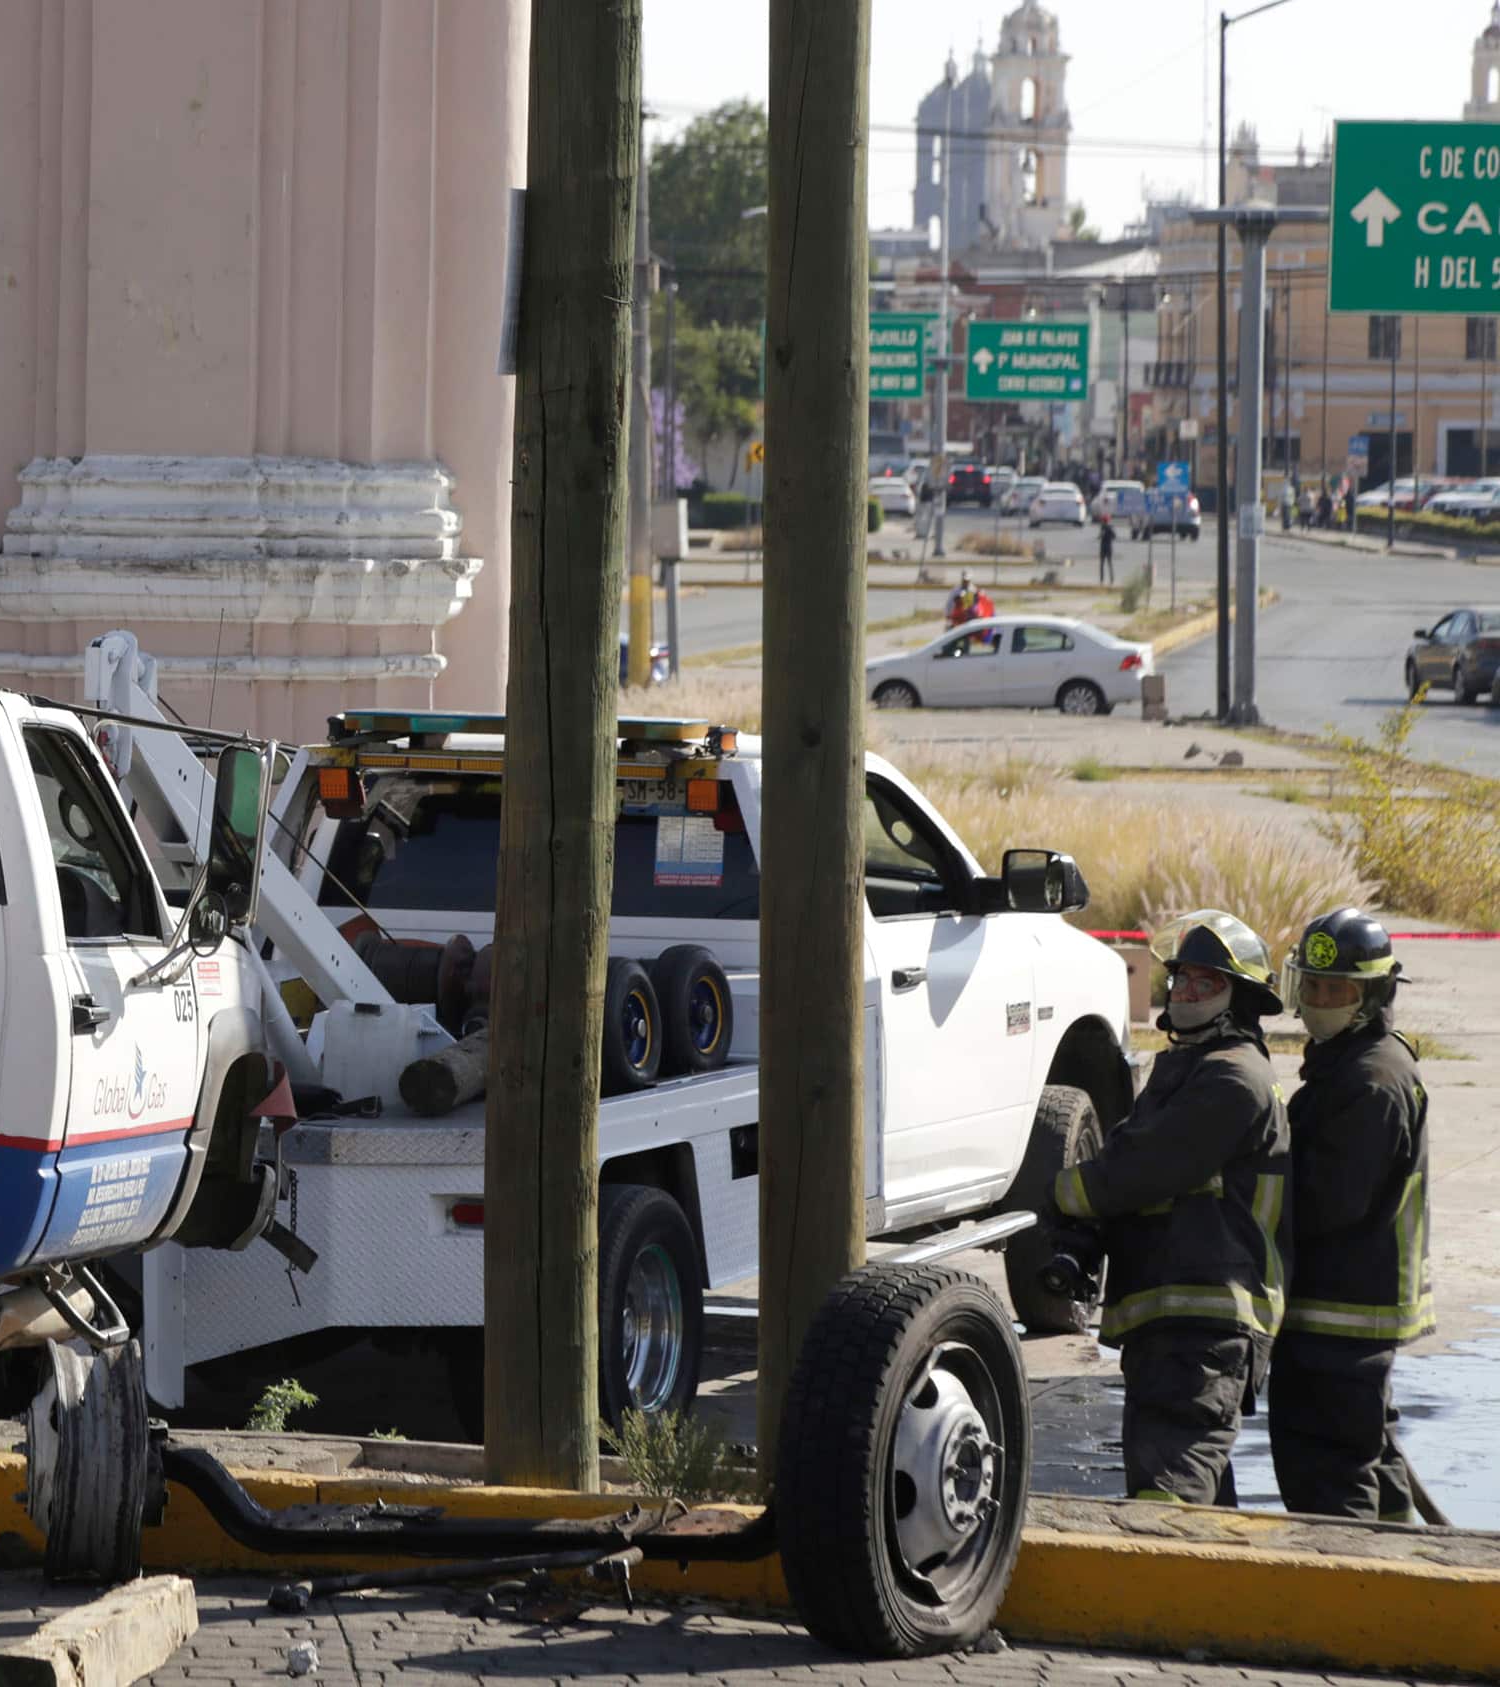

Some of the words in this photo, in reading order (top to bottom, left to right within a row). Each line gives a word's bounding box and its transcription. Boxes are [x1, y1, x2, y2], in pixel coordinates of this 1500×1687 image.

[1419, 145, 1432, 179] C
[1440, 145, 1466, 179] DE
[1416, 201, 1500, 236] CA
[1414, 255, 1430, 289] H
[1440, 255, 1481, 289] DEL
[1011, 352, 1080, 370] MUNICIPAL
[173, 989, 194, 1023] 025
[93, 1073, 131, 1116] Global
[147, 1073, 168, 1109] Gas
